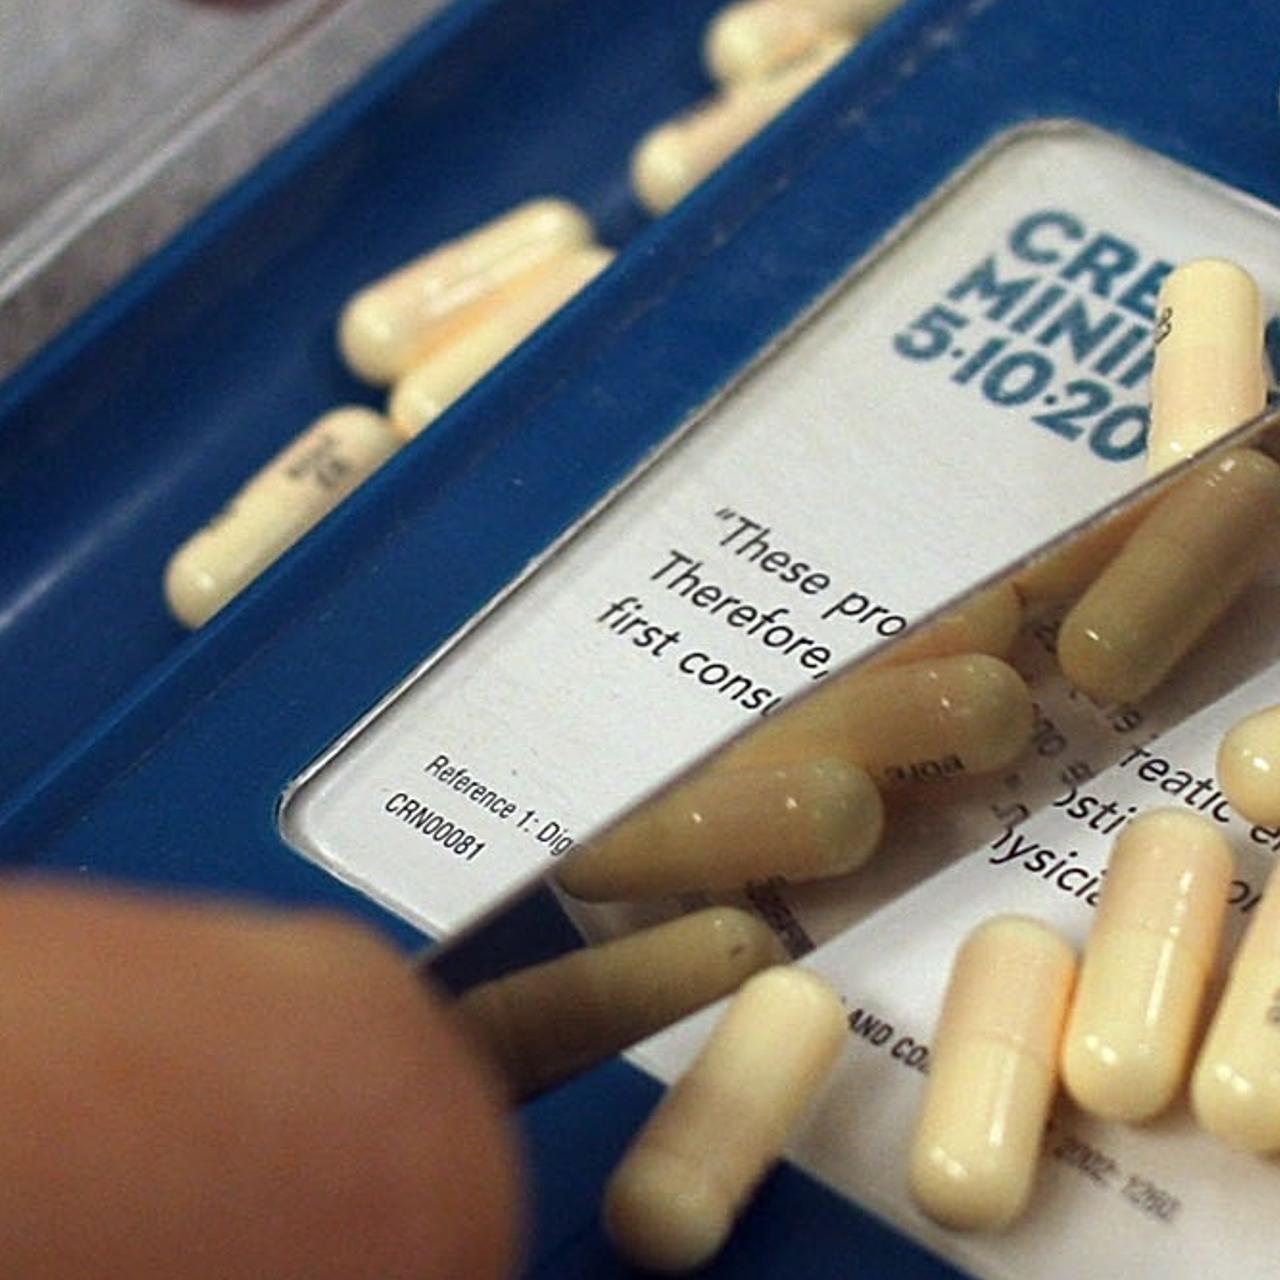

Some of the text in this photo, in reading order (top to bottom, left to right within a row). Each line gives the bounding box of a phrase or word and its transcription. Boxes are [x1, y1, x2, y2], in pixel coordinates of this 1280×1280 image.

[595, 597, 681, 657] first
[650, 550, 832, 681] Therefore,
[385, 792, 486, 861] CRN00081
[423, 754, 517, 819] Reference
[516, 809, 540, 833] 1:
[891, 1036, 931, 1075] CO
